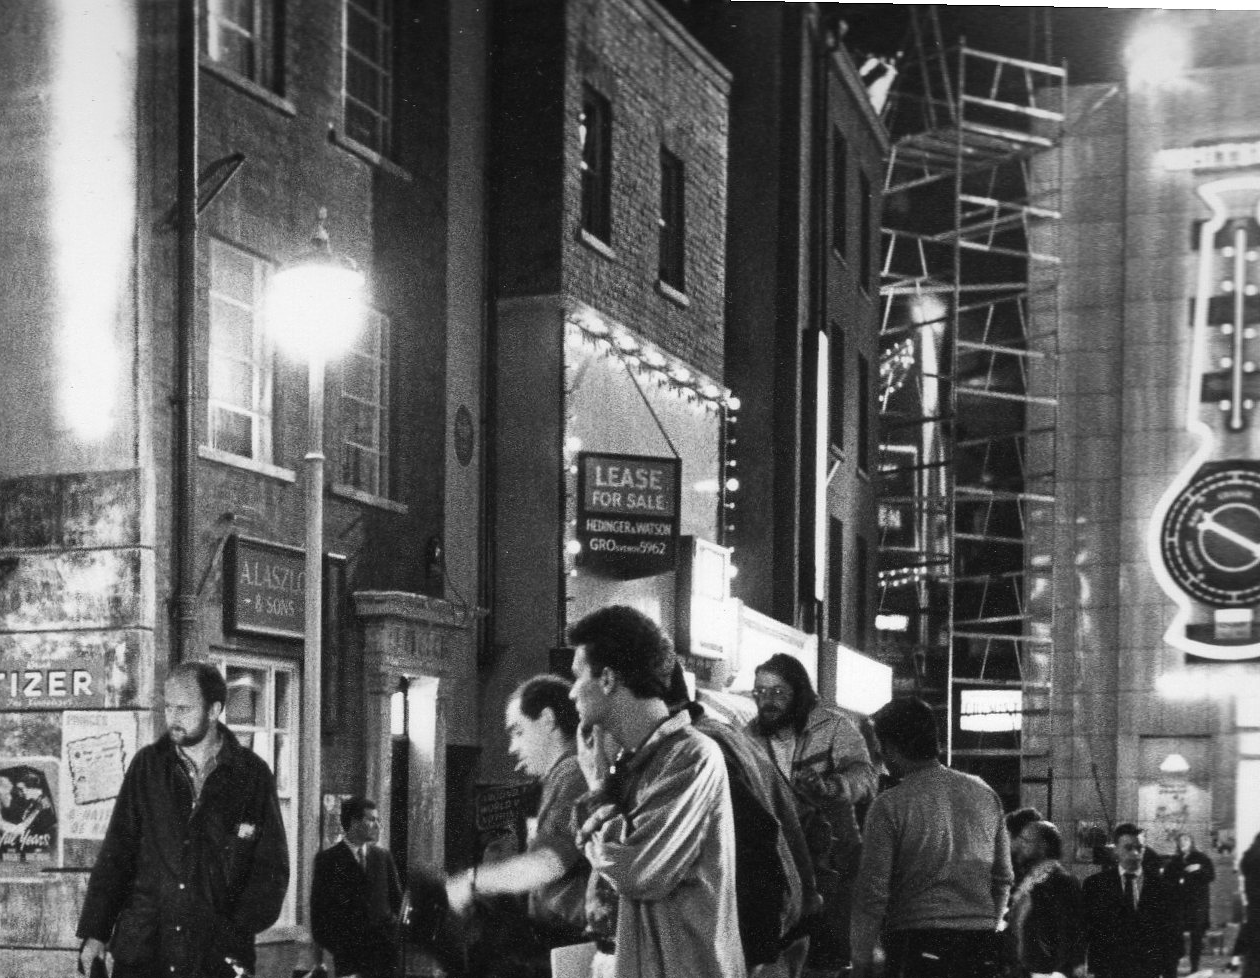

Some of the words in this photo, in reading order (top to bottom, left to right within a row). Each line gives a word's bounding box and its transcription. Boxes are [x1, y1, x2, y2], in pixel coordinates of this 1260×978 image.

[595, 466, 662, 490] LEASE
[592, 490, 621, 507] FOR
[626, 493, 665, 510] SALE
[266, 596, 295, 616] SONS
